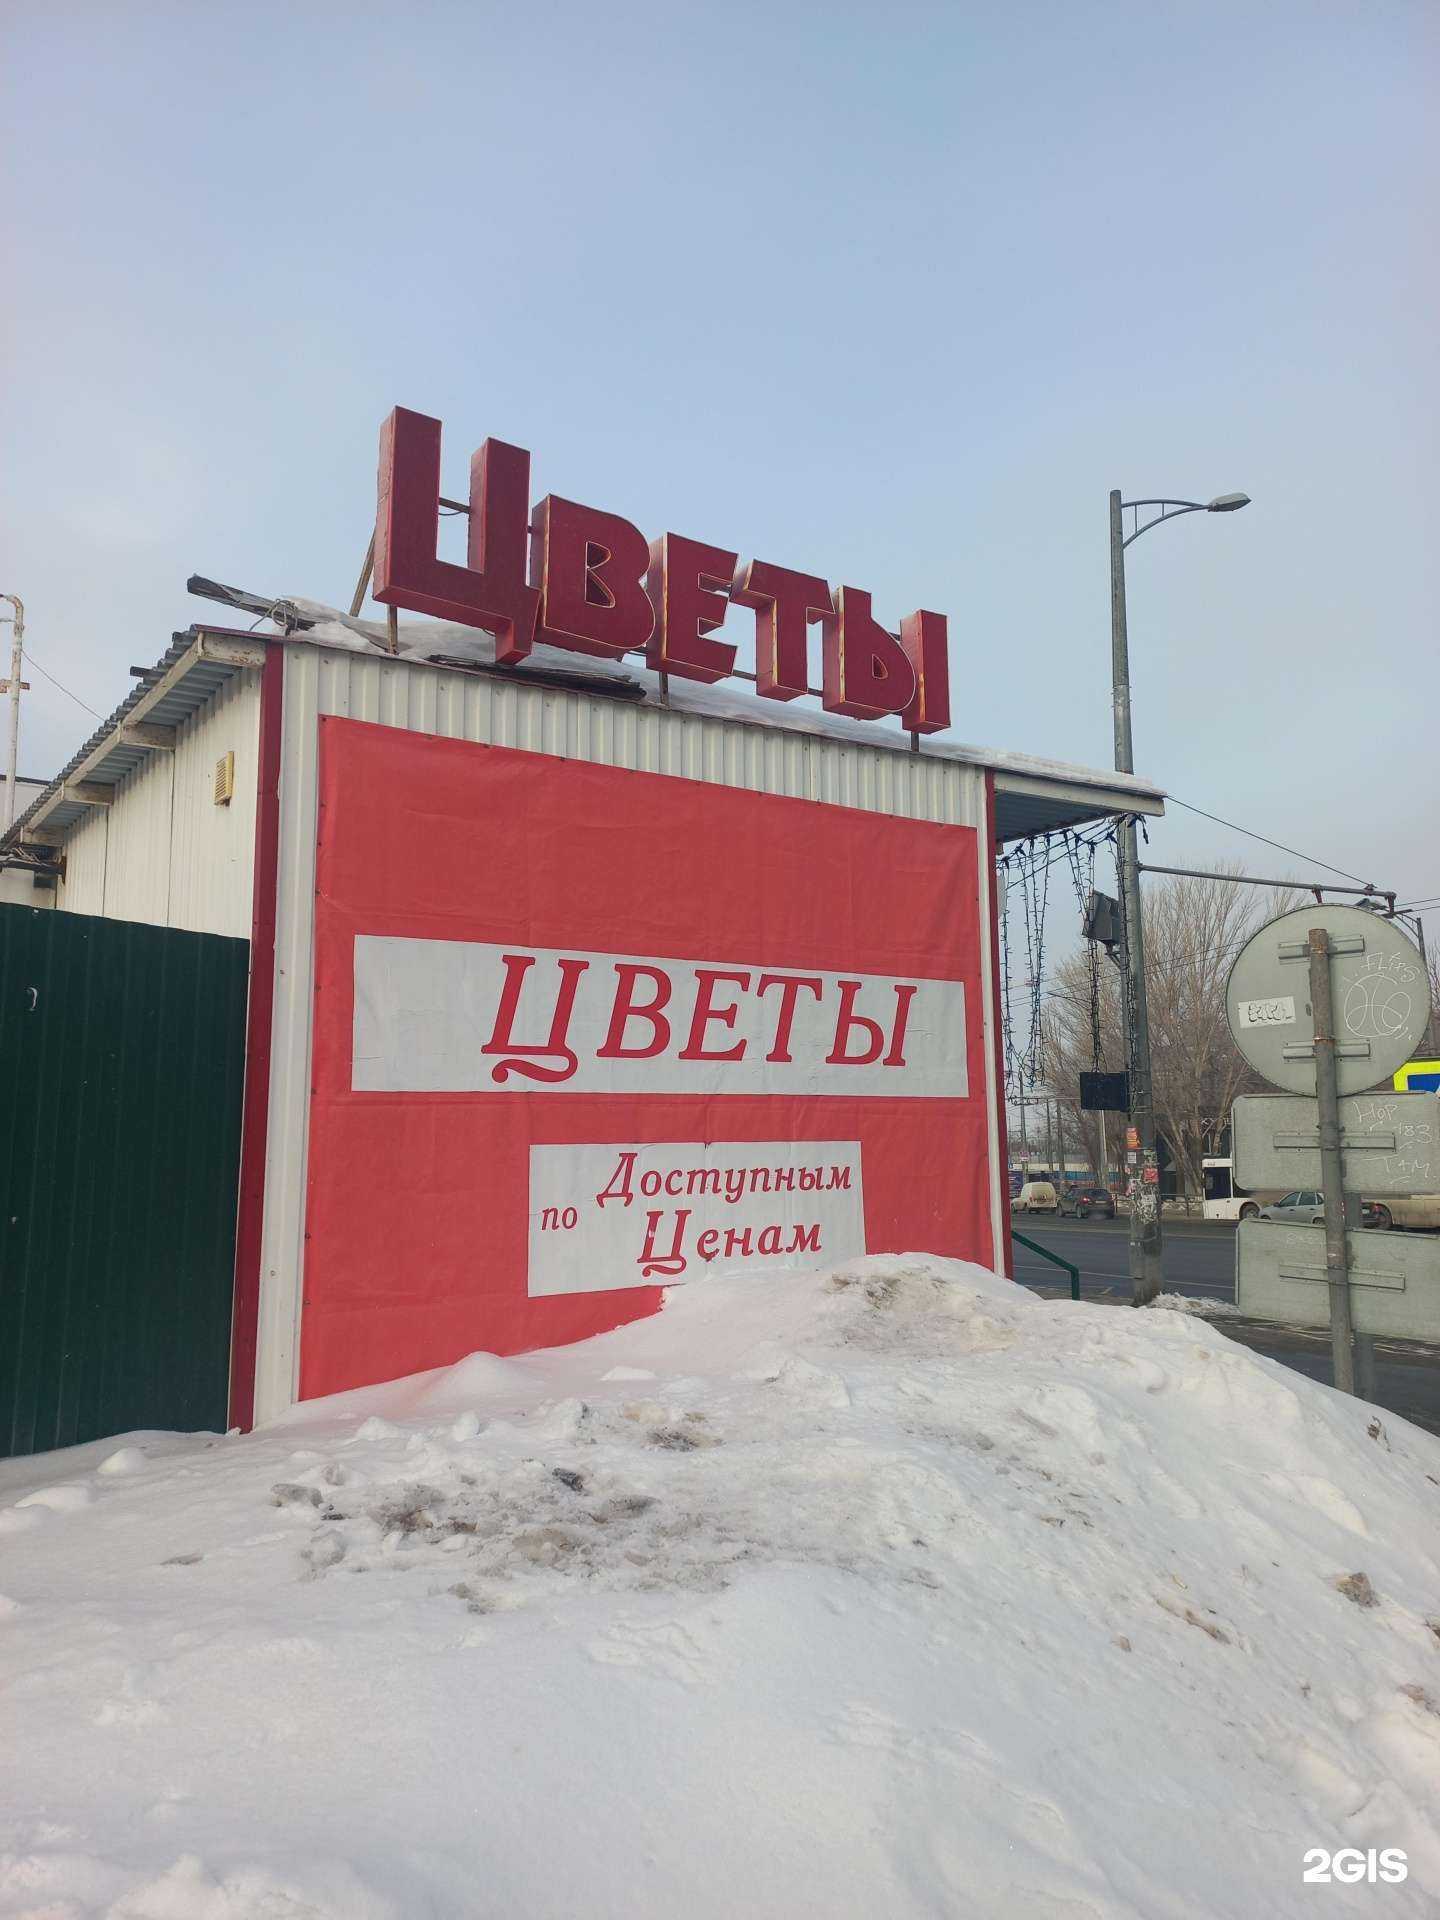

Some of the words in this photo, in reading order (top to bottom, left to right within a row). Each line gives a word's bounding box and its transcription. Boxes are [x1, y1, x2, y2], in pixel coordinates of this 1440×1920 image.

[372, 405, 951, 734] ЦВЕТЫ
[481, 954, 917, 1083] ЦВЕТЫ
[596, 1152, 852, 1208] Доступным
[540, 1205, 578, 1231] по
[636, 1209, 822, 1278] Ценам
